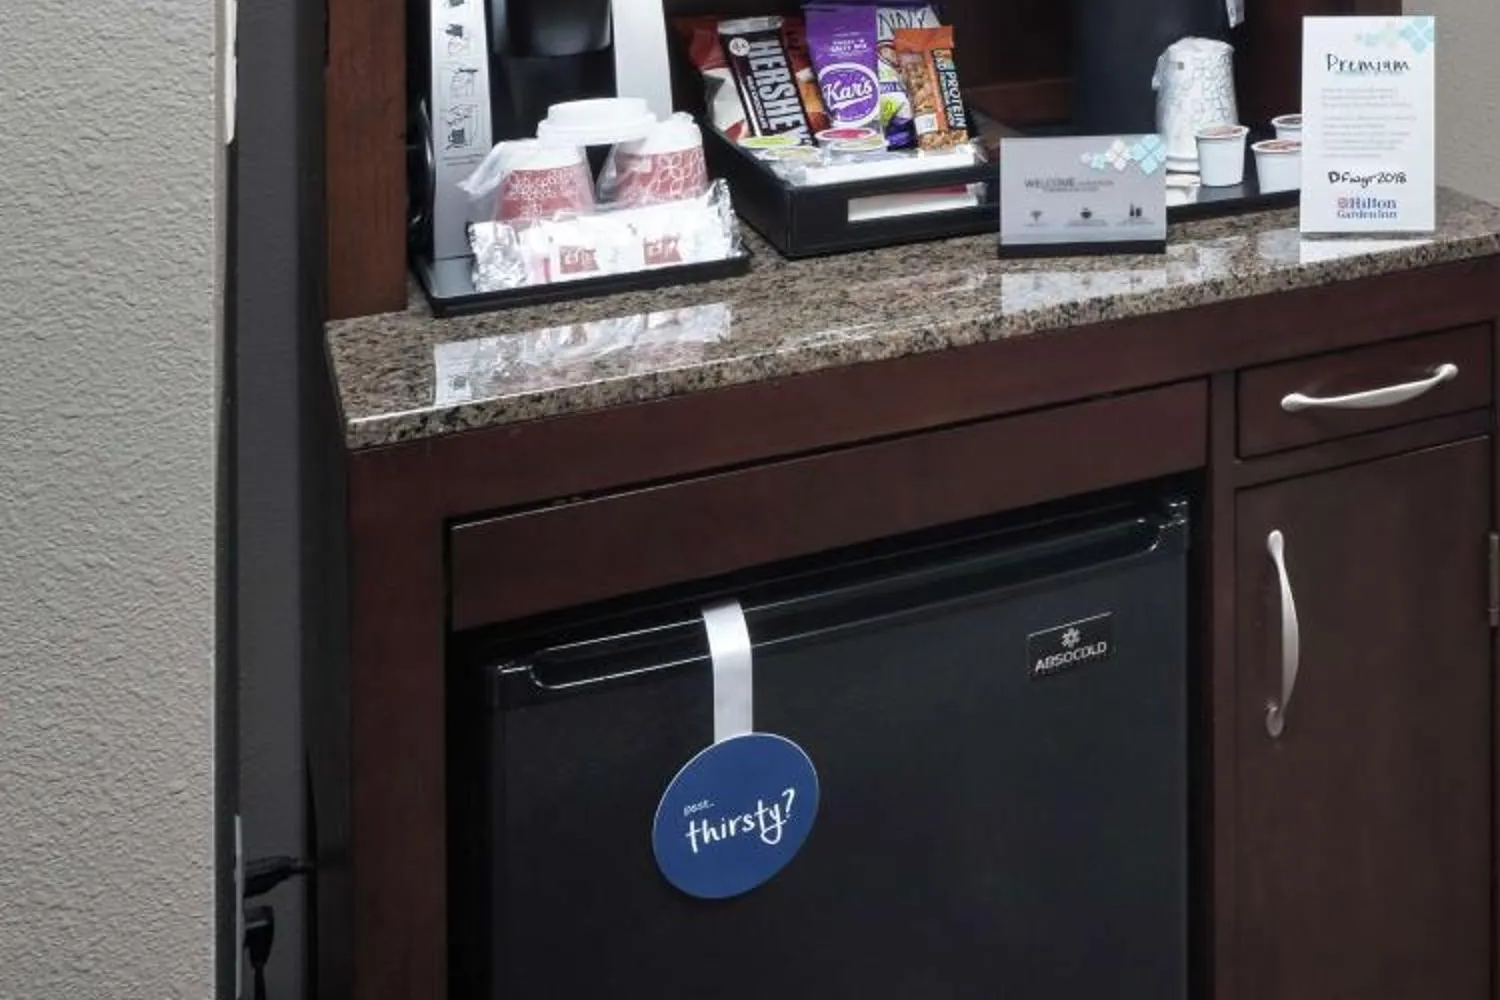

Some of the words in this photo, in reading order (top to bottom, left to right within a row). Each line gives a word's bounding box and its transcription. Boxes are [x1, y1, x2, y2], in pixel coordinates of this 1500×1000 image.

[1326, 53, 1411, 73] Premium
[748, 39, 808, 138] HERSHE
[945, 70, 968, 128] PROTEIN
[1349, 197, 1397, 210] Hilton
[1035, 641, 1107, 673] ABSOCOLD
[685, 787, 795, 854] thirsty?
